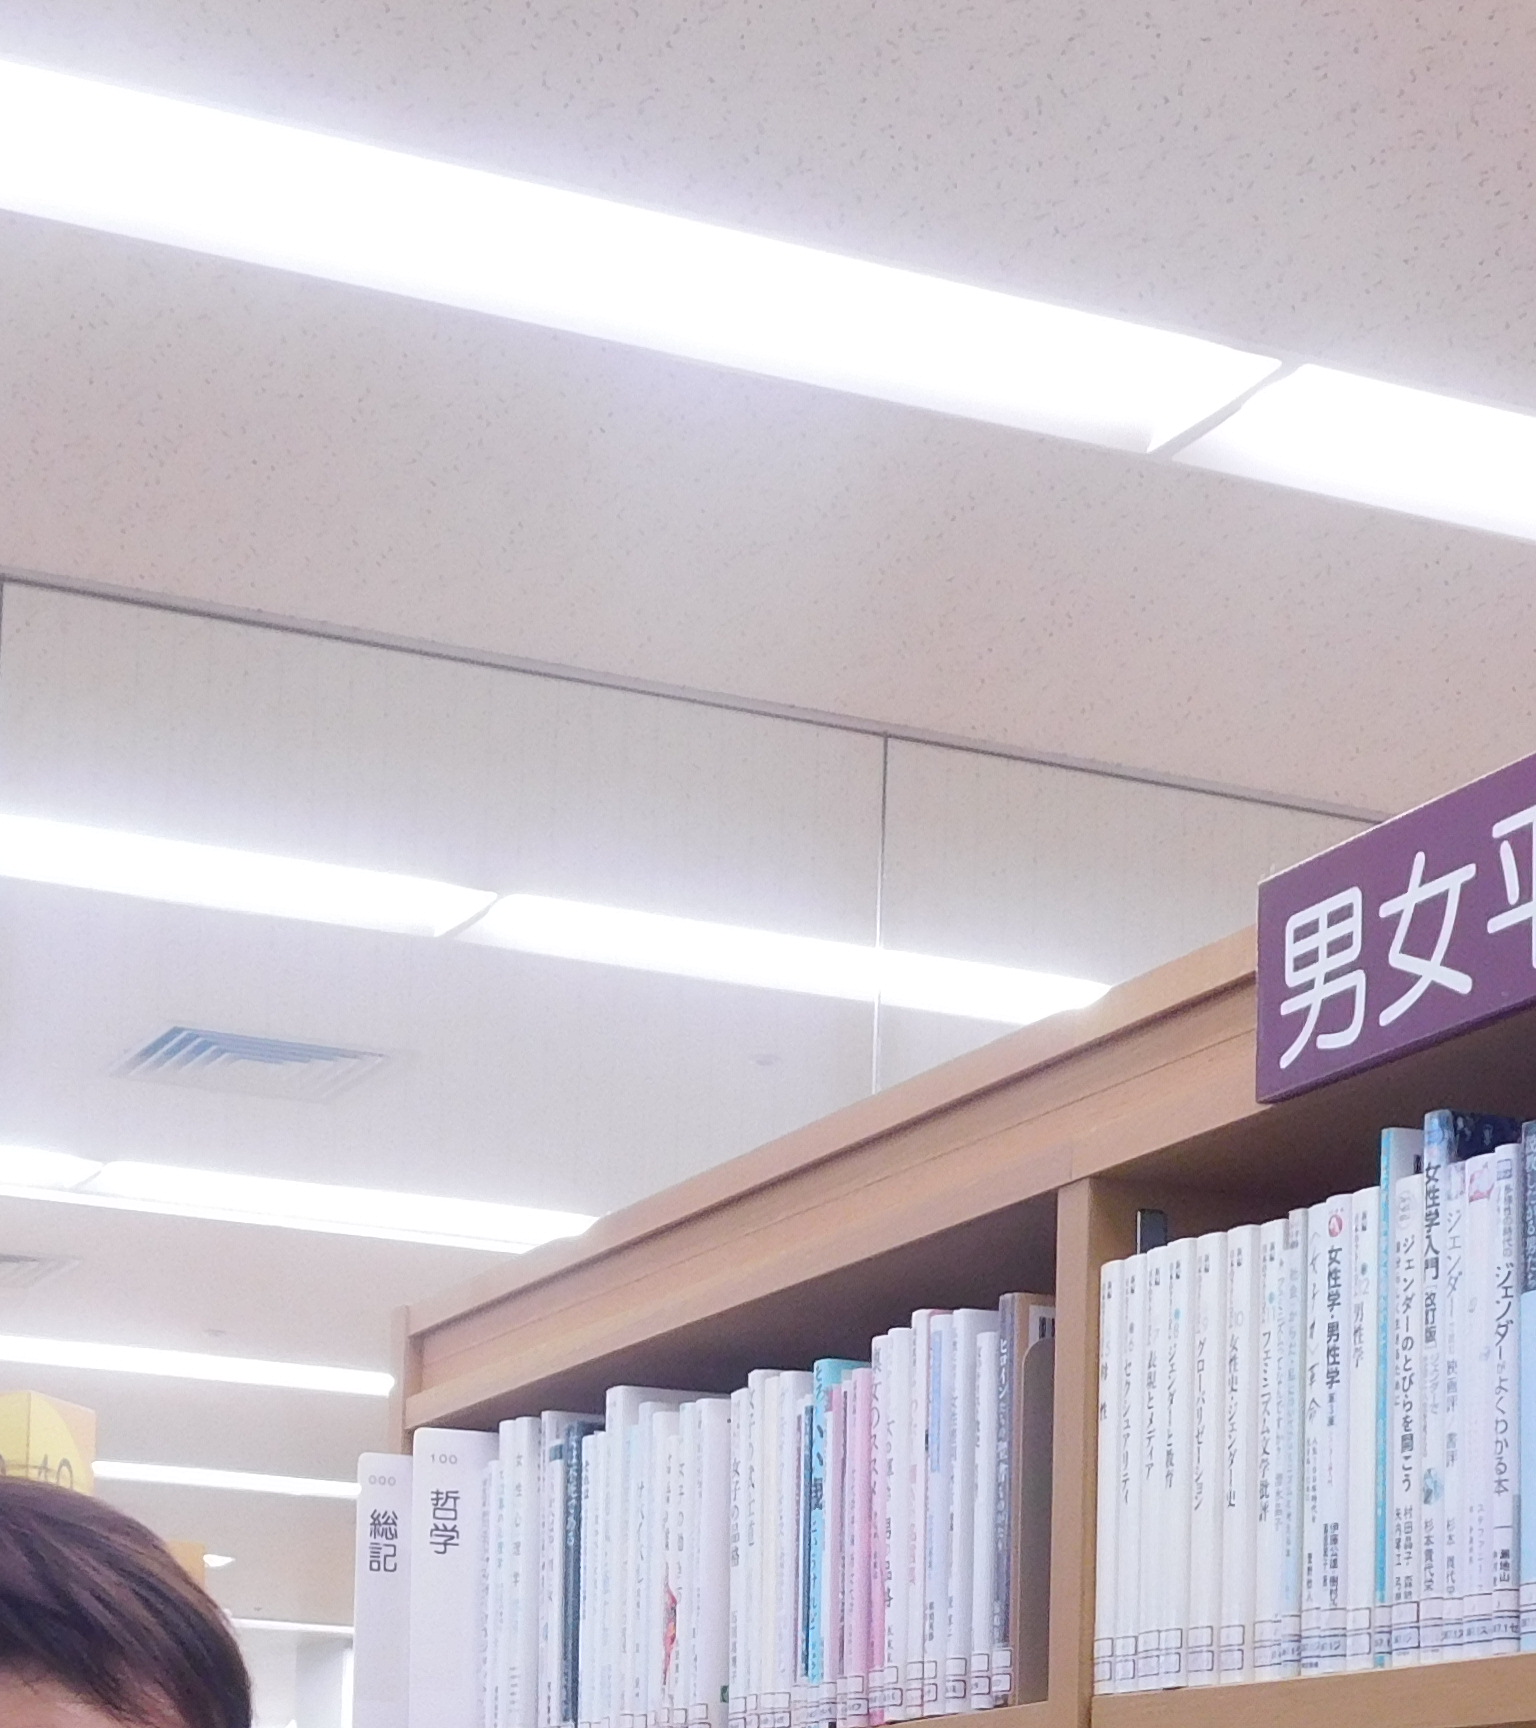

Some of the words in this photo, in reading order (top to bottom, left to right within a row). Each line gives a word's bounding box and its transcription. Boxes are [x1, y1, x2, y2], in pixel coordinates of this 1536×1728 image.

[1424, 1162, 1440, 1281] 女性学入門
[1325, 1245, 1343, 1388] 女性学・男性学
[1352, 1300, 1365, 1370] 男性学
[1399, 1235, 1416, 1494] ジェンダーのとびらを開こう
[1494, 1265, 1514, 1495] ジェンダーがよくわかる本
[367, 1475, 397, 1487] 000
[430, 1452, 458, 1465] 100
[1120, 1357, 1132, 1506] セクシュアリティ
[1144, 1348, 1158, 1482] 表現とメディア
[1164, 1344, 1178, 1490] ジェンダーと教育
[1193, 1337, 1208, 1512] グローバリゼーション
[1225, 1335, 1239, 1508] 女性史・ジェンダー史
[1258, 1331, 1272, 1523] フェミニズム文学批評
[368, 1508, 399, 1573] 総記
[429, 1489, 461, 1555] 哲学
[729, 1454, 741, 1567] 女子の品格
